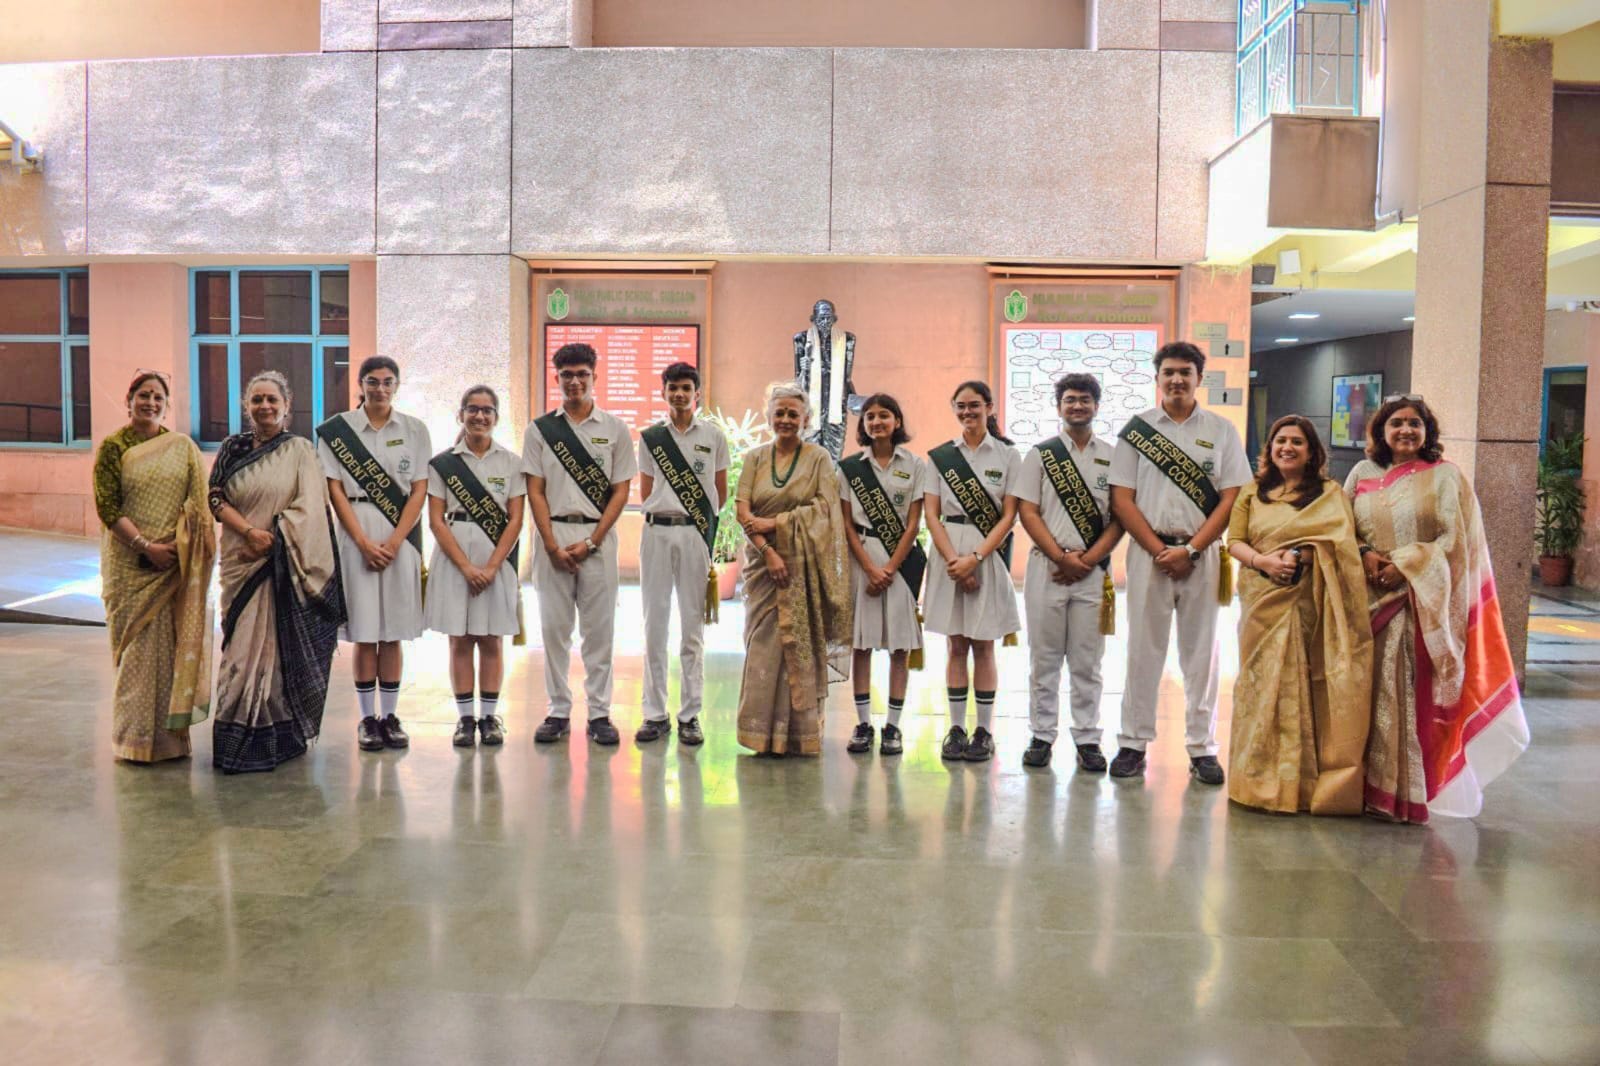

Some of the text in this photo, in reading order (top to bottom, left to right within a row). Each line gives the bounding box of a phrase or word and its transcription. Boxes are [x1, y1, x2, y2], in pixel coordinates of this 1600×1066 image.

[363, 457, 391, 489] HEAD
[553, 441, 591, 485] STUDENT
[585, 463, 609, 492] HEAD
[1126, 430, 1207, 509] STUDENT COUNCIL
[1150, 433, 1204, 481] PRESIDENT
[331, 437, 368, 482] STUDENT
[365, 481, 400, 525] COUNCIL
[447, 474, 483, 518] STUDENT
[653, 445, 685, 493] STUDENT
[680, 491, 710, 535] COUNCIL
[681, 467, 704, 500] HEAD
[851, 476, 883, 522] STUDENT
[944, 468, 979, 513] STUDENT
[965, 477, 997, 521] PRESIDE
[1040, 449, 1095, 545] STUDENT COUNCIL
[1060, 459, 1098, 519] PRESIDENT
[480, 495, 503, 525] HEAD
